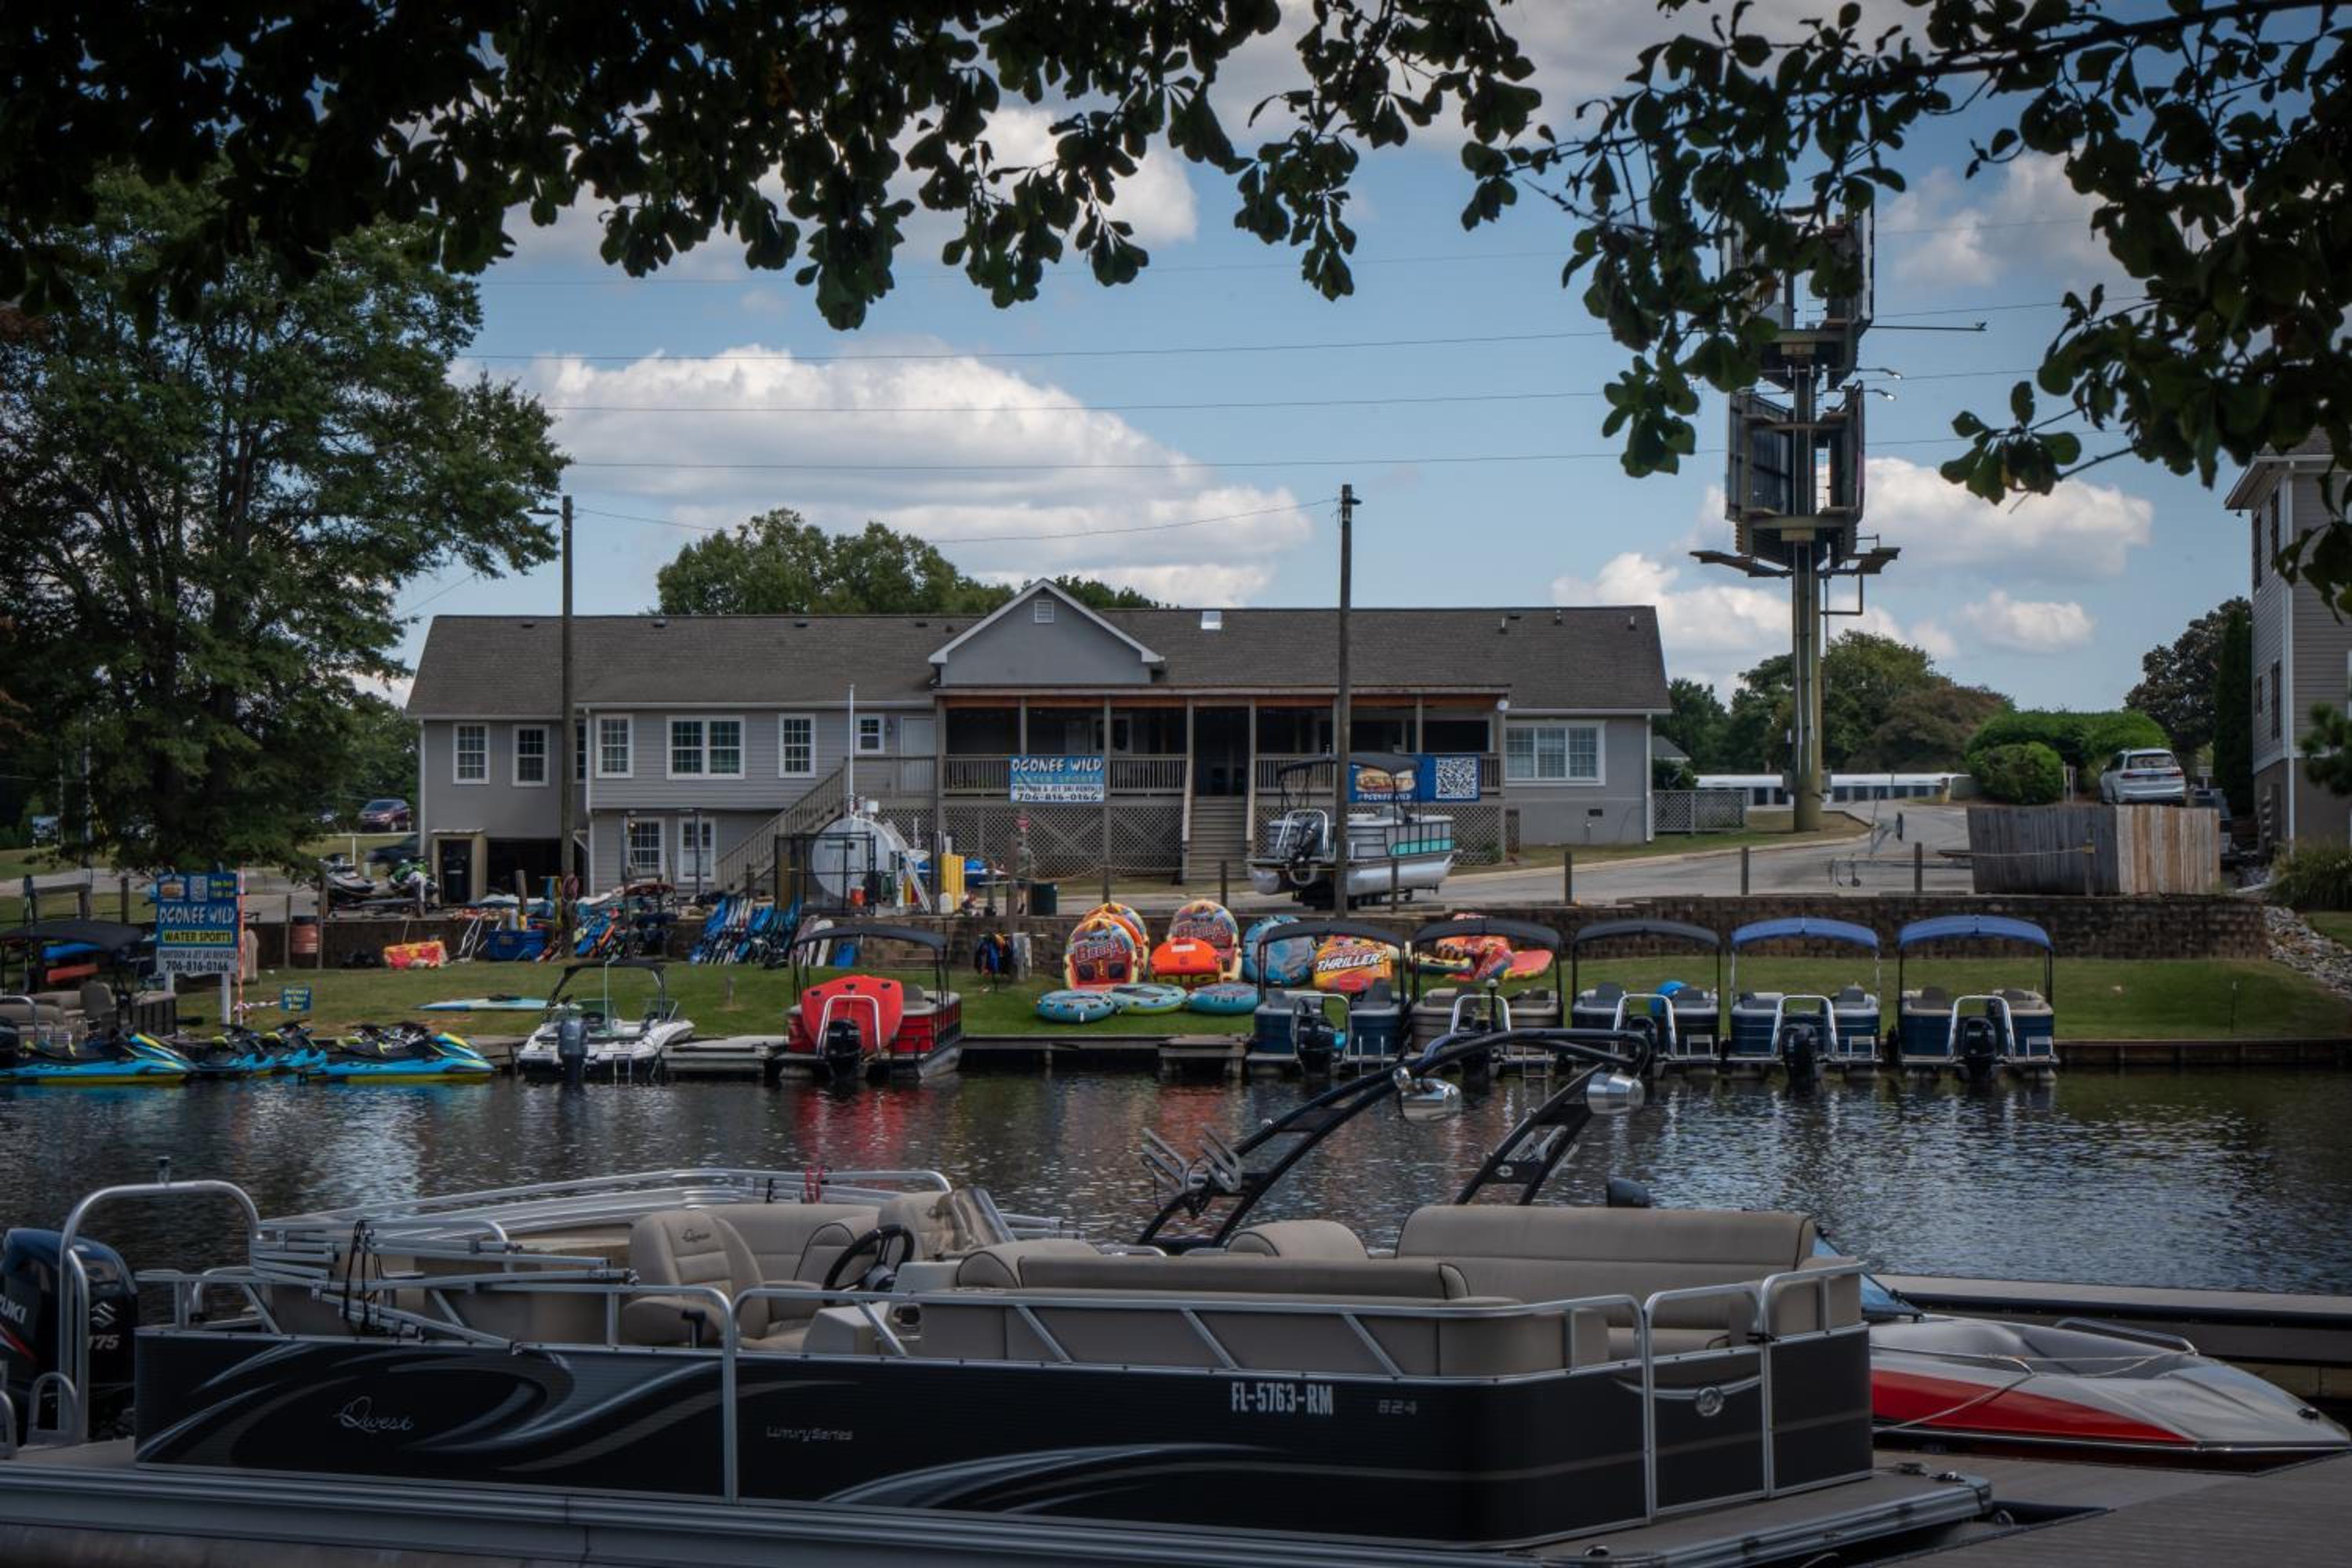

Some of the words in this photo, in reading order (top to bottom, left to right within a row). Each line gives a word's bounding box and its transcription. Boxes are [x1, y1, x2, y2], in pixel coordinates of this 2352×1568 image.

[1012, 758, 1065, 772] OCONEE
[1071, 758, 1102, 771] WILD
[159, 906, 206, 924] OCONEE
[209, 906, 235, 924] WILD
[164, 932, 196, 942] WATER
[199, 932, 231, 942] SPORTS
[165, 960, 229, 971] 706-816-0166
[1316, 953, 1381, 972] THRILLER
[1230, 1381, 1334, 1416] FL-5763-RM
[332, 1395, 415, 1434] Qwest
